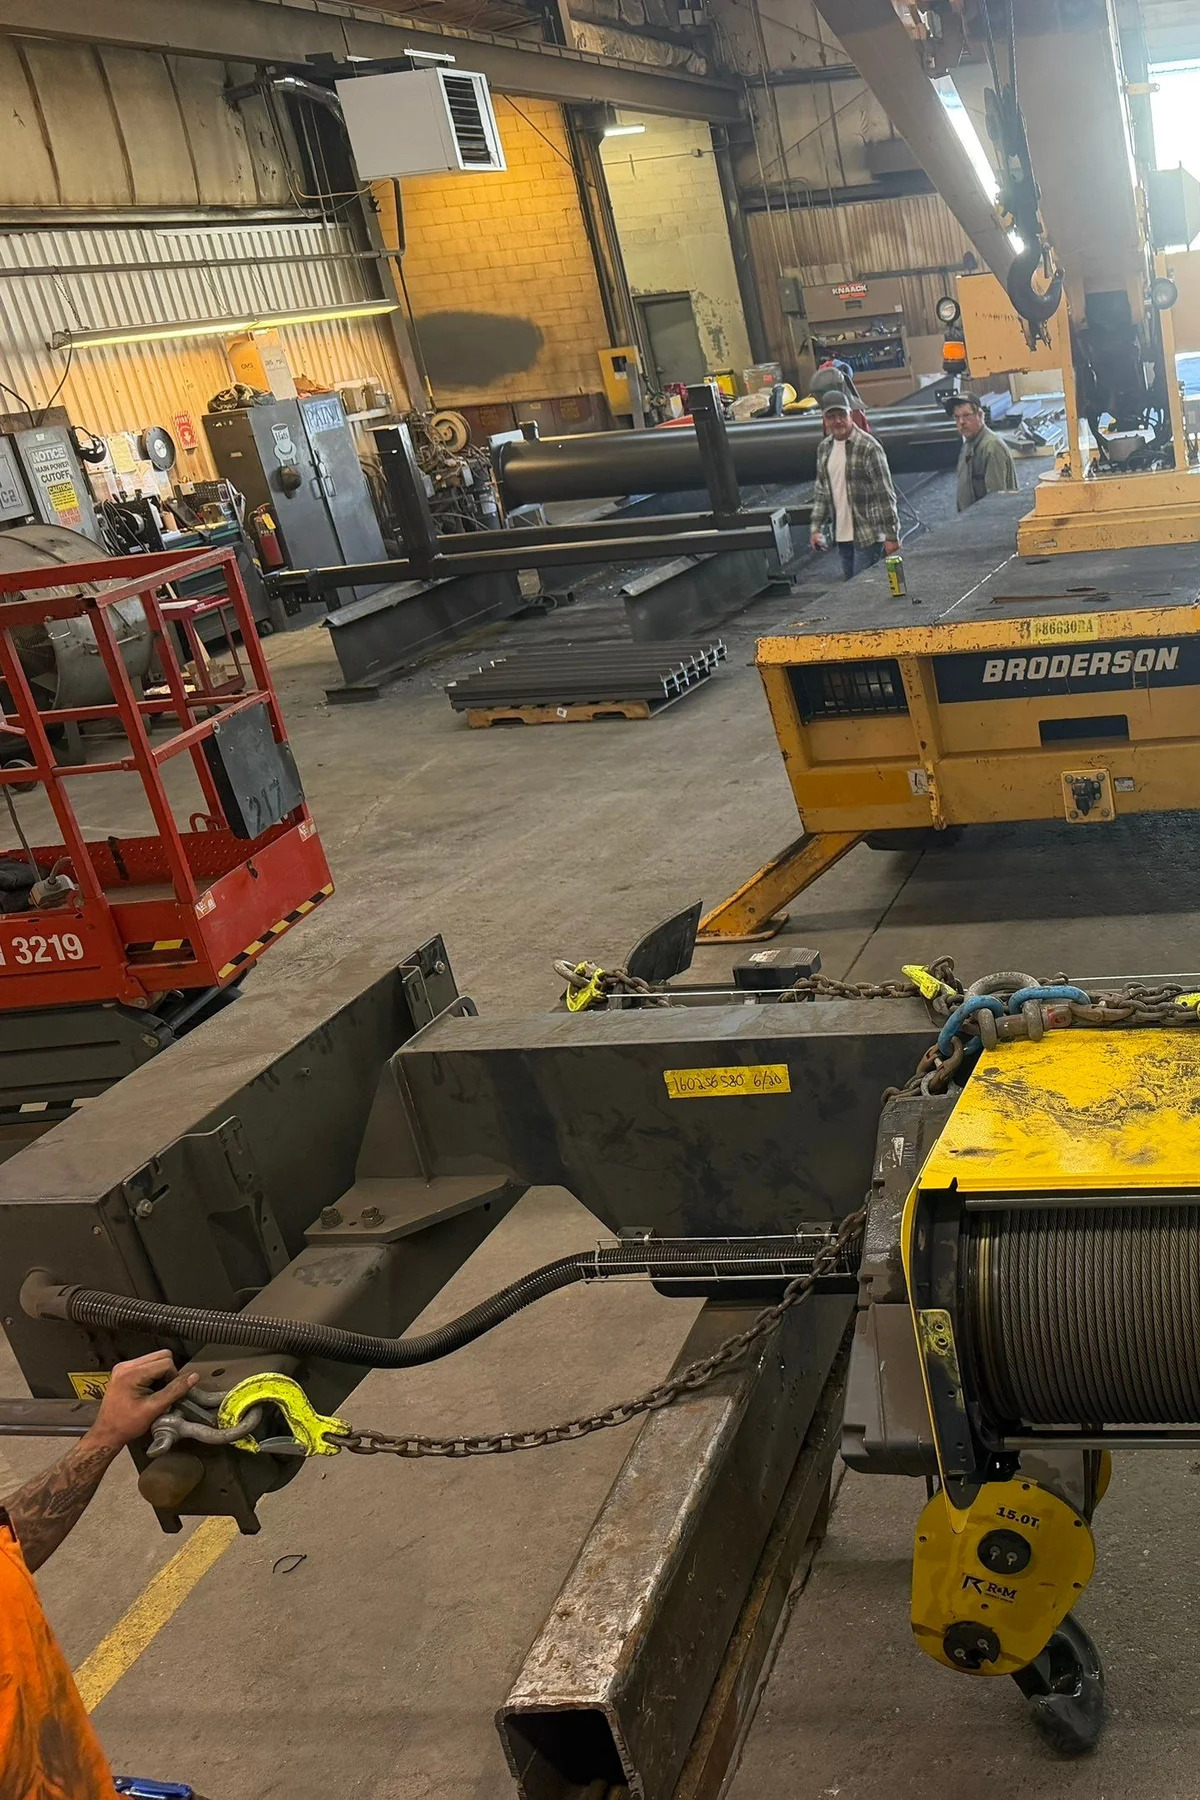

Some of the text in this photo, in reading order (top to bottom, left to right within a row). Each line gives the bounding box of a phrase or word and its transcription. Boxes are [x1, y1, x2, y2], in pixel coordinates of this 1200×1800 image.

[832, 285, 867, 295] KNAACK
[306, 404, 341, 427] PAINT
[32, 447, 65, 463] NOTICE
[35, 461, 69, 473] MAIN POWER
[41, 470, 70, 483] CUTOFF
[48, 483, 73, 494] CAUTION
[982, 647, 1180, 683] BRODERSON
[12, 933, 84, 965] 3219
[996, 1507, 1040, 1528] 15.0T
[986, 1582, 1017, 1599] R&M
